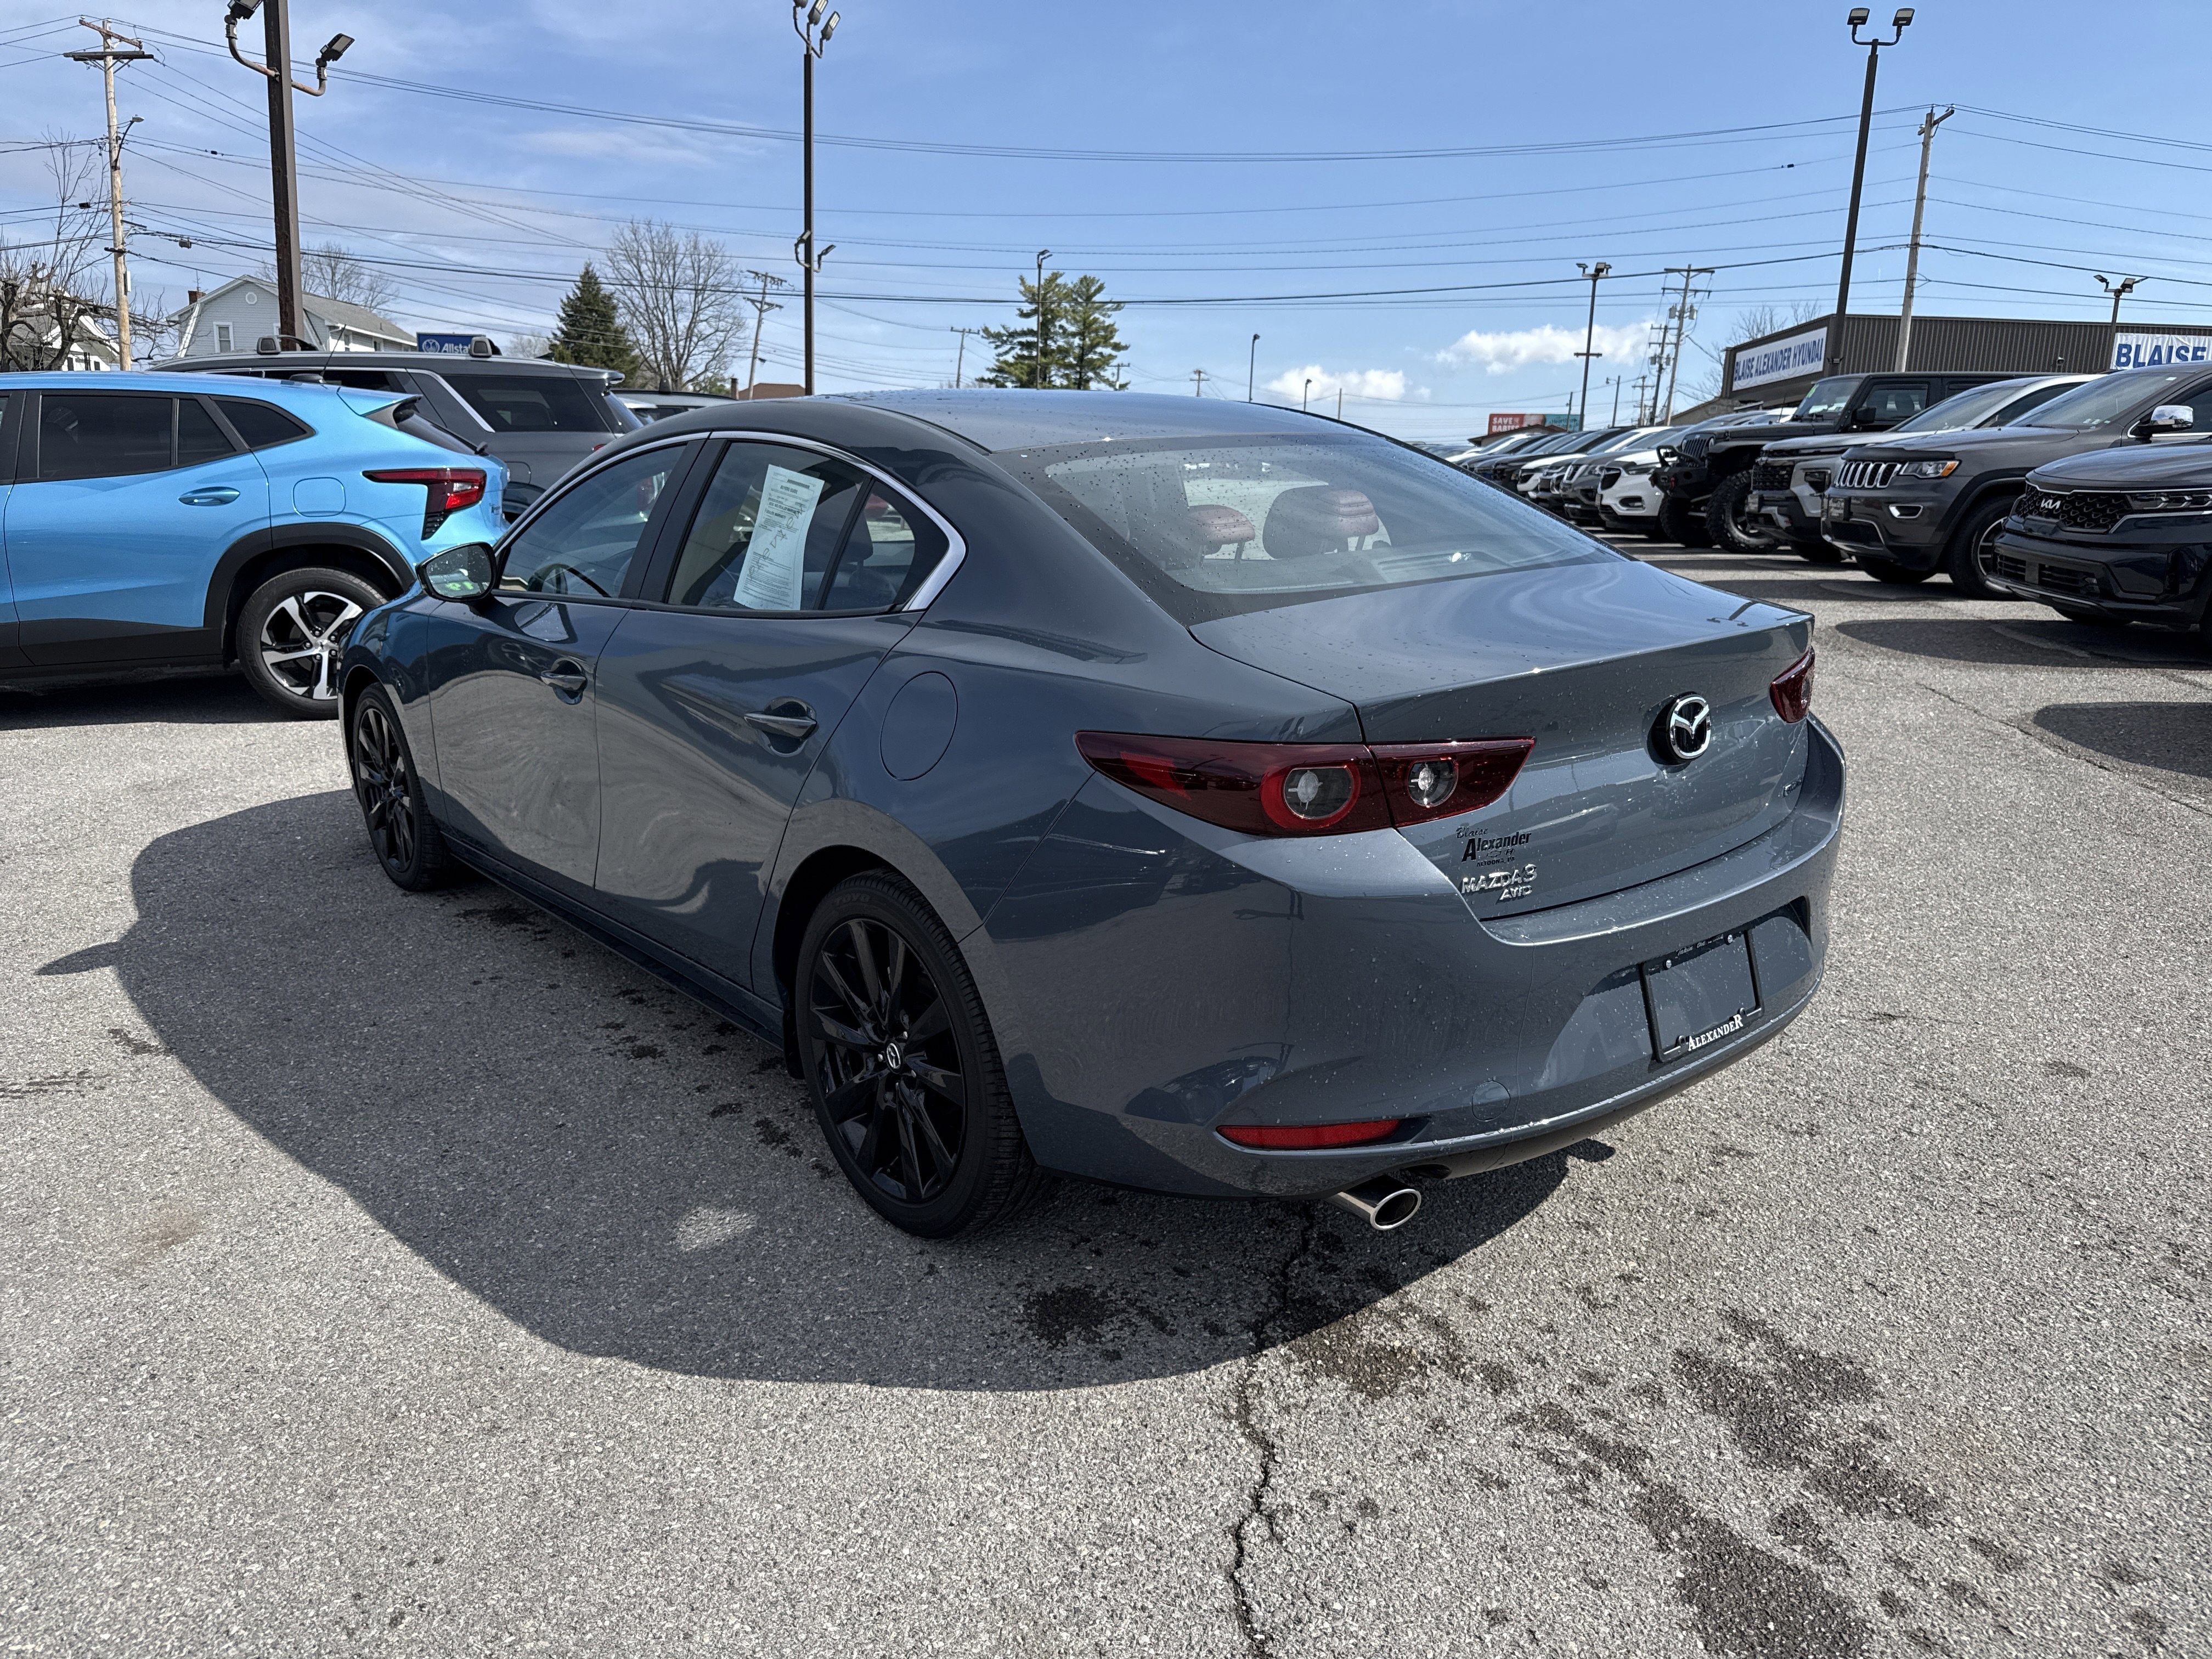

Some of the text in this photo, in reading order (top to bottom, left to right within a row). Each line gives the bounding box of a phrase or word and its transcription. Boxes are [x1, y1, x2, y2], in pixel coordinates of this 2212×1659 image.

[442, 342, 470, 354] Allsta
[1734, 338, 1824, 381] BLAISE ALEXANDER HYUNDAI
[2115, 343, 2207, 368] BLAISE
[1456, 826, 1488, 838] Blaise
[1462, 831, 1532, 862] Alexander
[1461, 864, 1537, 894] MAZDA3
[1499, 885, 1532, 900] AWD
[1688, 1014, 1743, 1051] ALEXANDER
